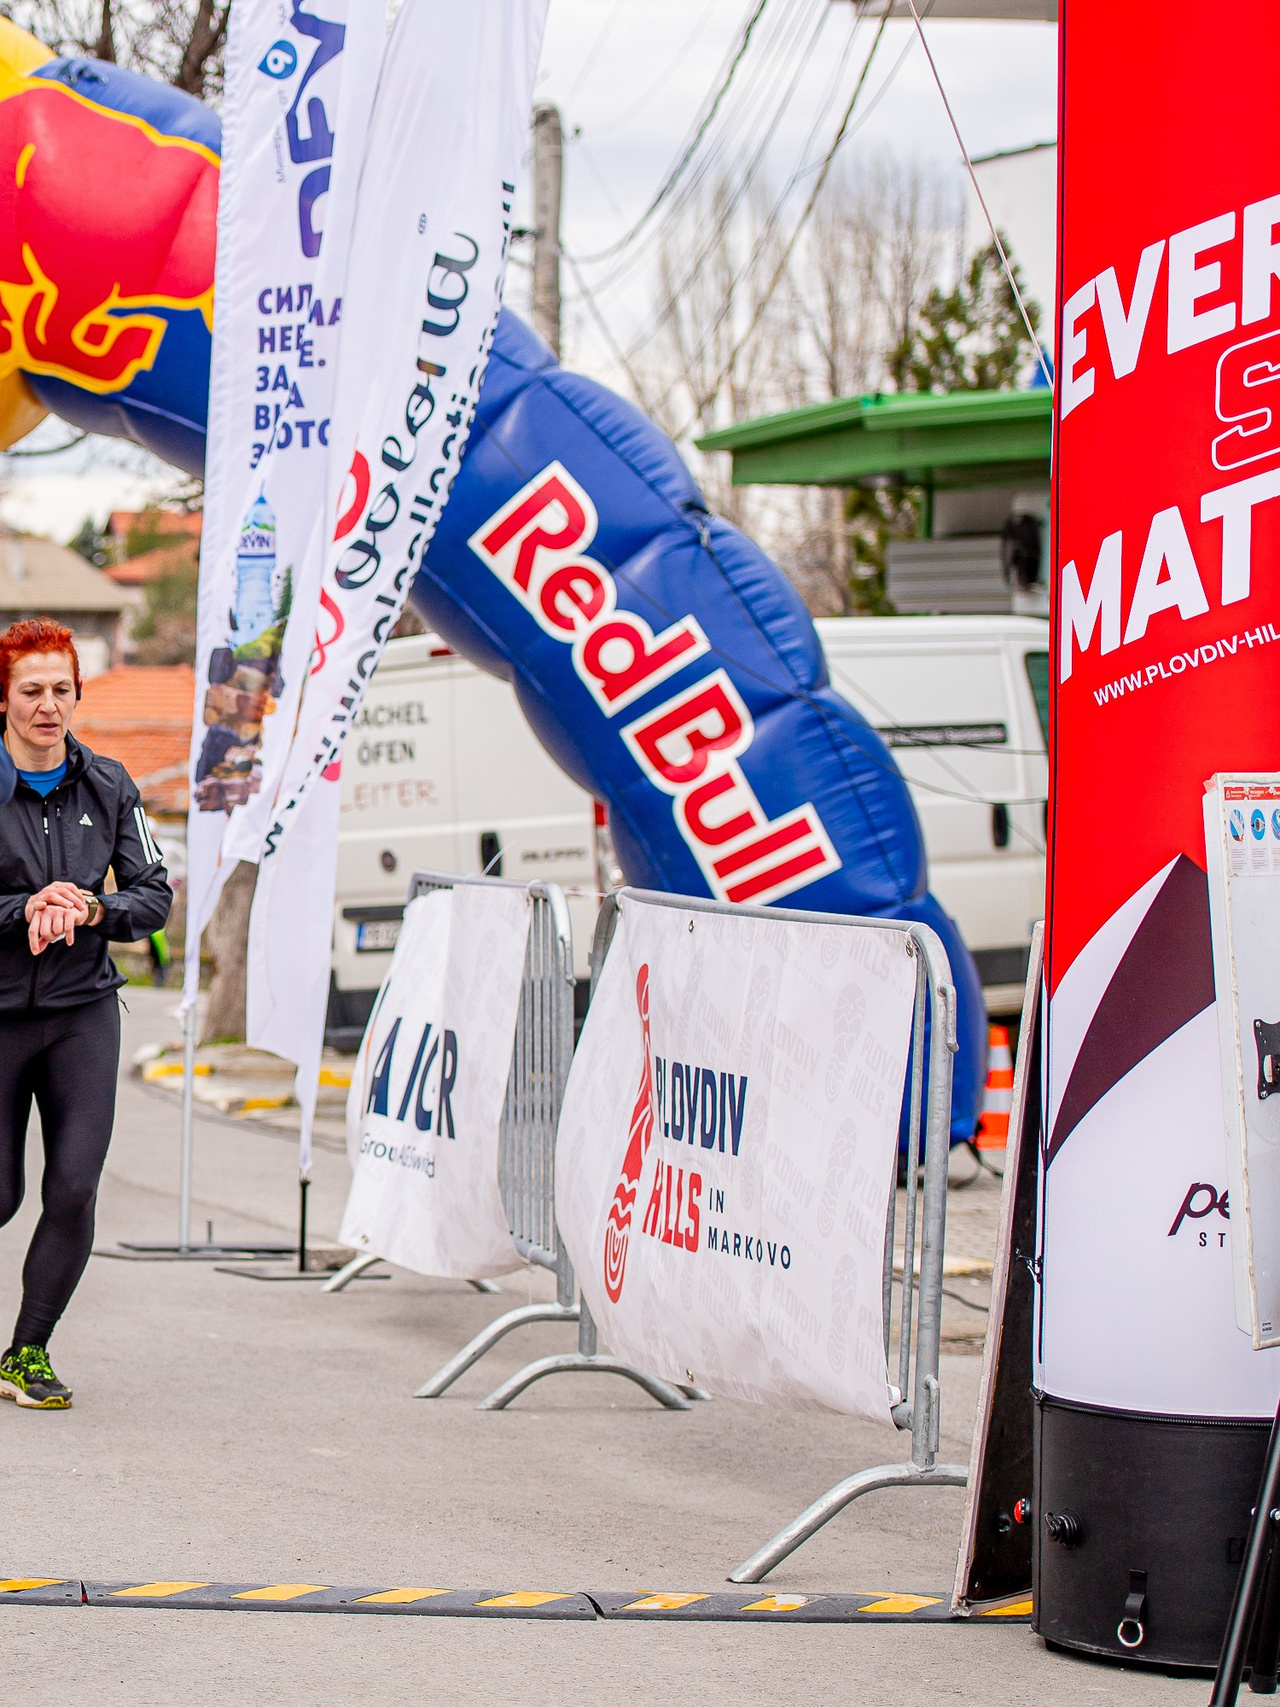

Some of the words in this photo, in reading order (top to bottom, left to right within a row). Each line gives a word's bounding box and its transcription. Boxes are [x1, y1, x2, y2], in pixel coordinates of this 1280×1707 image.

[1061, 468, 1280, 685] MAT
[480, 474, 699, 704] Red
[632, 681, 828, 904] Bull
[1093, 622, 1280, 707] WWW.PLOVDIV-HIL
[655, 1055, 749, 1157] PLOVDIV
[642, 1157, 703, 1254] HLLS
[709, 1187, 725, 1214] IN
[708, 1225, 792, 1270] MARKOVO
